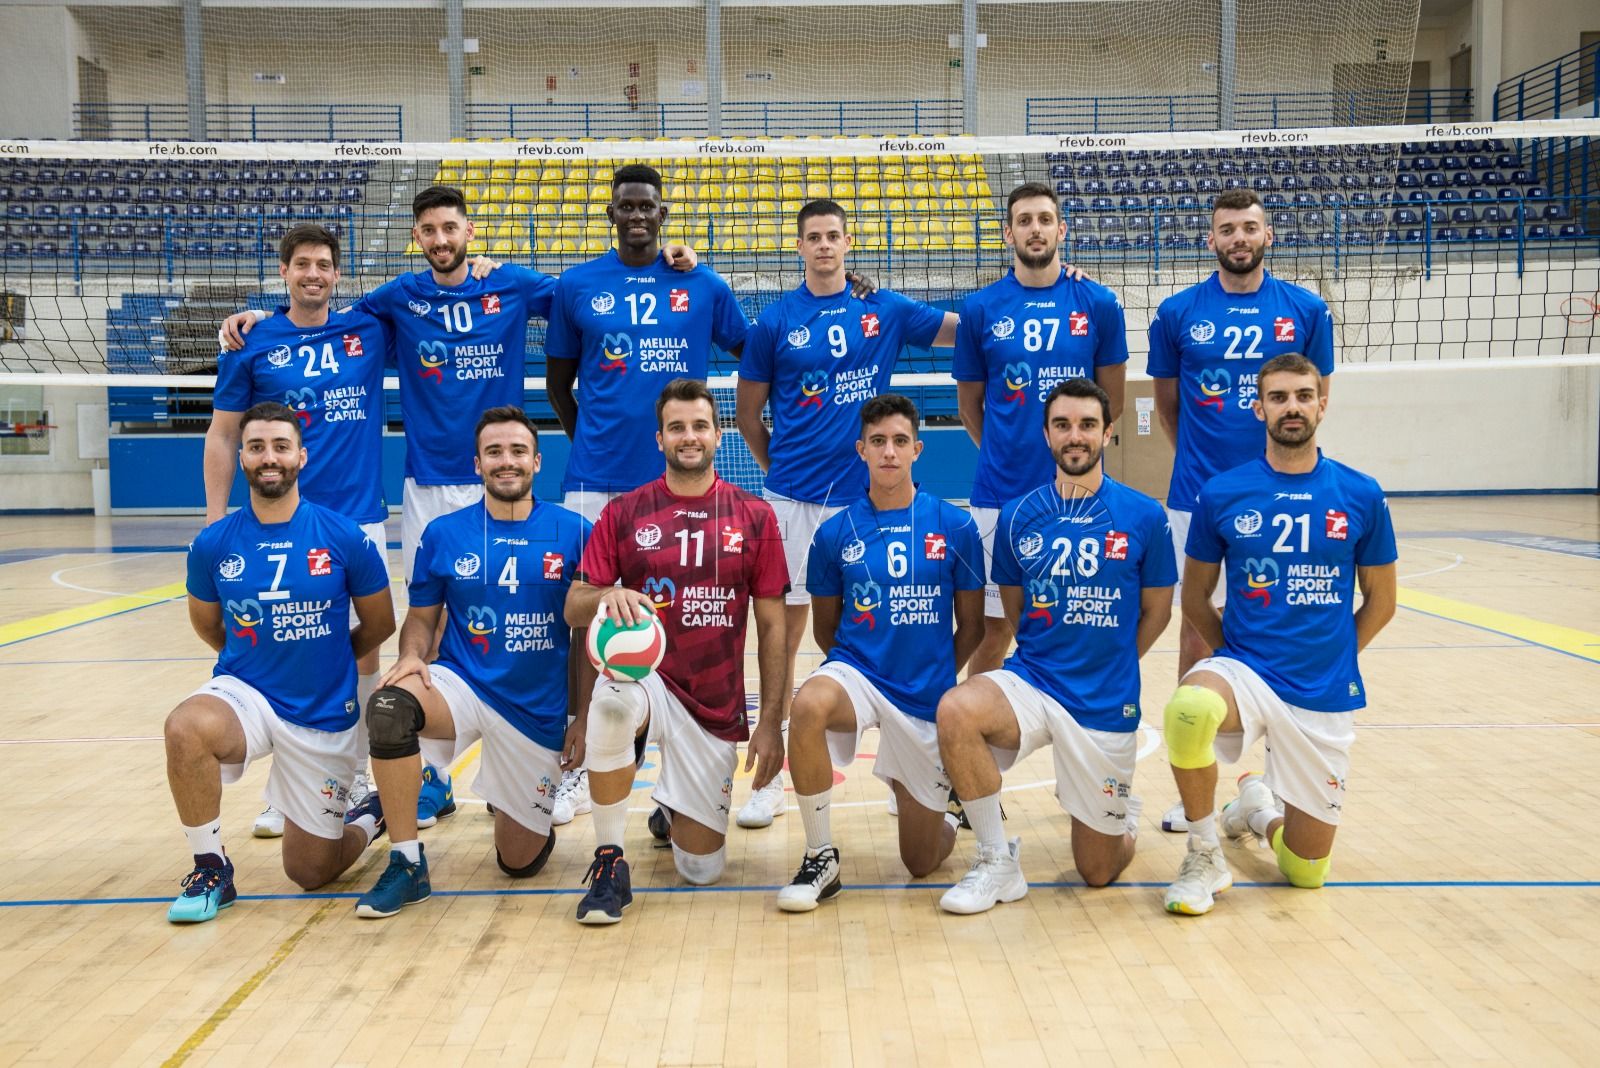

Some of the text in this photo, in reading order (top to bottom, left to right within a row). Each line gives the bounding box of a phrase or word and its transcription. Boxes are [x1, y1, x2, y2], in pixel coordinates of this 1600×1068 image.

[698, 142, 765, 153] rfevb.com
[879, 140, 946, 152] rfevb.com
[1060, 136, 1126, 148] rfevb.com
[334, 144, 402, 156] rfevb.com
[518, 144, 584, 155] rfevb.com
[624, 292, 658, 325] 12
[438, 301, 472, 333] 10
[828, 324, 848, 358] 9
[1024, 318, 1060, 352] 87
[1224, 325, 1263, 359] 22
[640, 338, 688, 348] MELILLA
[454, 344, 504, 357] MELILLA
[640, 350, 680, 360] SPORT
[298, 343, 340, 378] 24
[456, 356, 497, 369] SPORT
[640, 362, 688, 373] CAPITAL
[456, 367, 504, 380] CAPITAL
[836, 364, 879, 384] MELILLA
[1038, 366, 1086, 378] MELILLA
[836, 378, 873, 394] SPORT
[1039, 379, 1070, 390] SPO
[324, 386, 367, 401] MELILLA
[834, 388, 877, 405] CAPITAL
[325, 398, 359, 410] SPORT
[325, 409, 366, 422] CAPITAL
[1272, 514, 1310, 553] 21
[674, 529, 704, 567] 11
[887, 541, 908, 578] 6
[1050, 537, 1100, 578] 28
[268, 554, 287, 592] 7
[498, 557, 520, 594] 4
[1287, 564, 1340, 577] MELILLA
[889, 585, 941, 598] MELILLA
[1287, 578, 1333, 591] SPORT
[682, 586, 736, 600] MELILLA
[1066, 586, 1122, 600] MELILLA
[1286, 592, 1342, 605] CAPITAL
[271, 600, 332, 615] MELILLA
[682, 600, 727, 613] SPORT
[890, 598, 934, 612] SPORT
[1067, 600, 1112, 614] SPORT
[272, 612, 322, 628] SPORT
[504, 612, 555, 625] MELILLA
[682, 614, 734, 627] CAPITAL
[890, 612, 939, 626] CAPITAL
[1062, 613, 1120, 628] CAPITAL
[273, 623, 332, 642] CAPITAL
[505, 626, 548, 638] SPORT
[505, 638, 554, 652] CAPITAL
